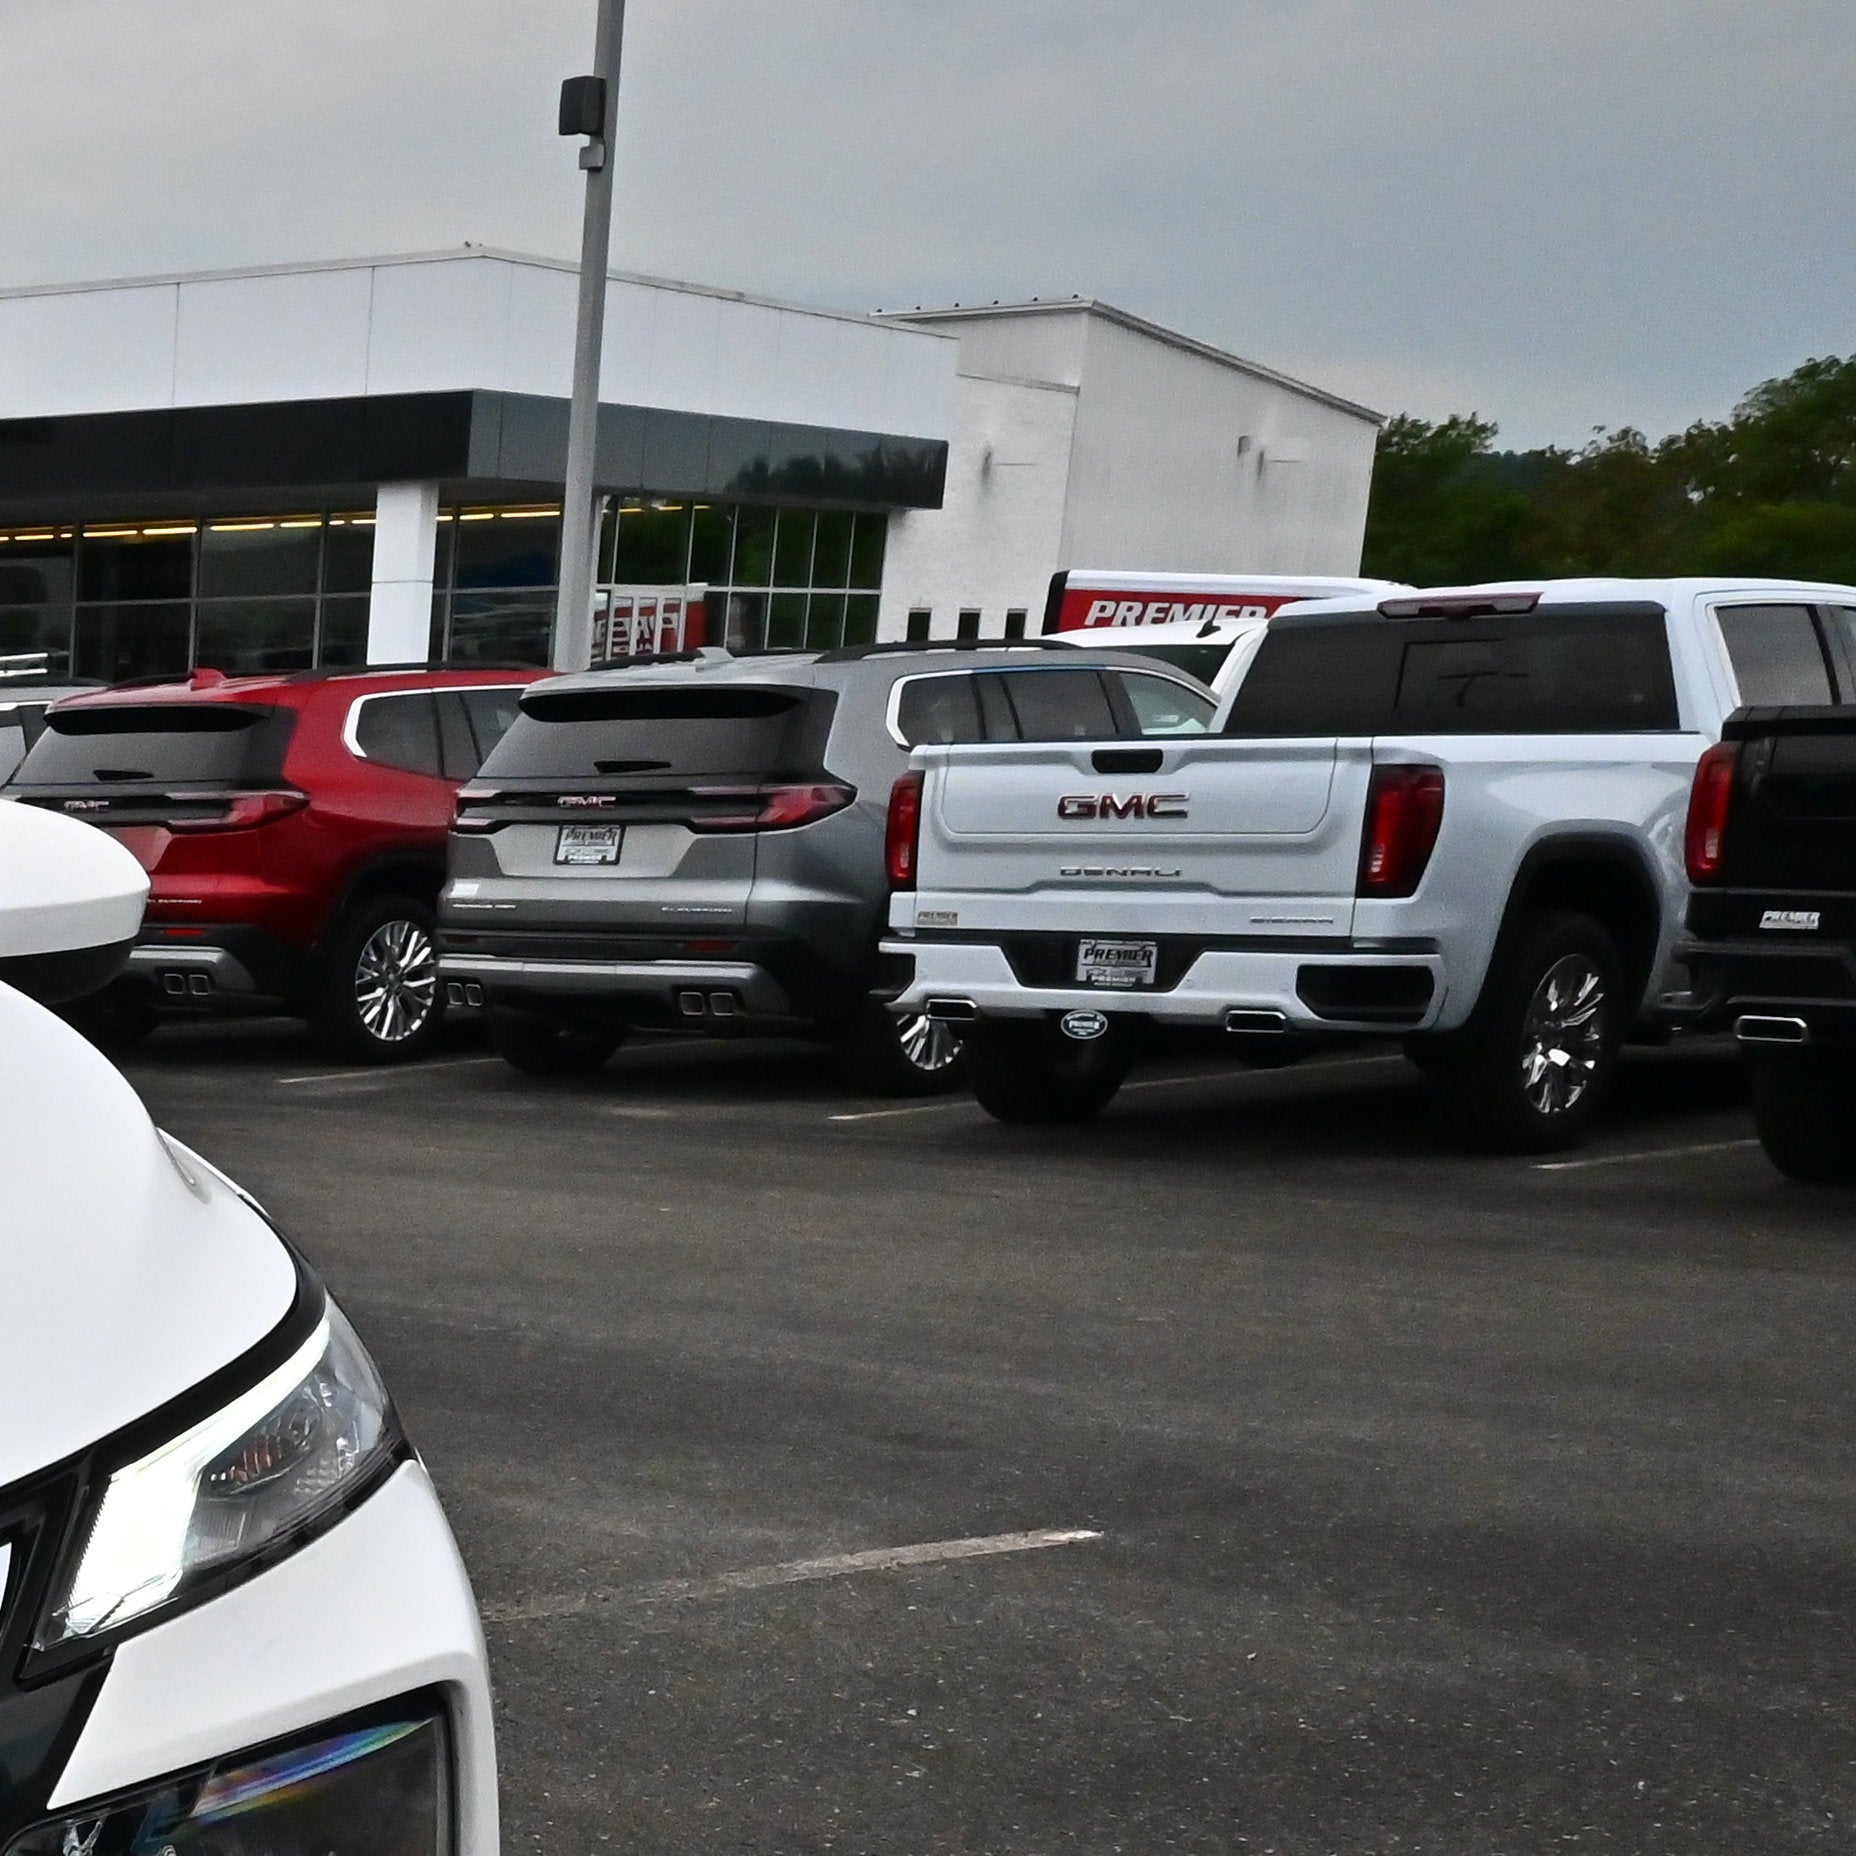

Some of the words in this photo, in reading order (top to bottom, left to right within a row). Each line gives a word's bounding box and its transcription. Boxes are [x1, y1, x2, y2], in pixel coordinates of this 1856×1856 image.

[557, 795, 617, 809] GMC
[1056, 792, 1190, 820] GMC
[1059, 866, 1182, 877] DENALI
[1083, 948, 1154, 966] PREMIER
